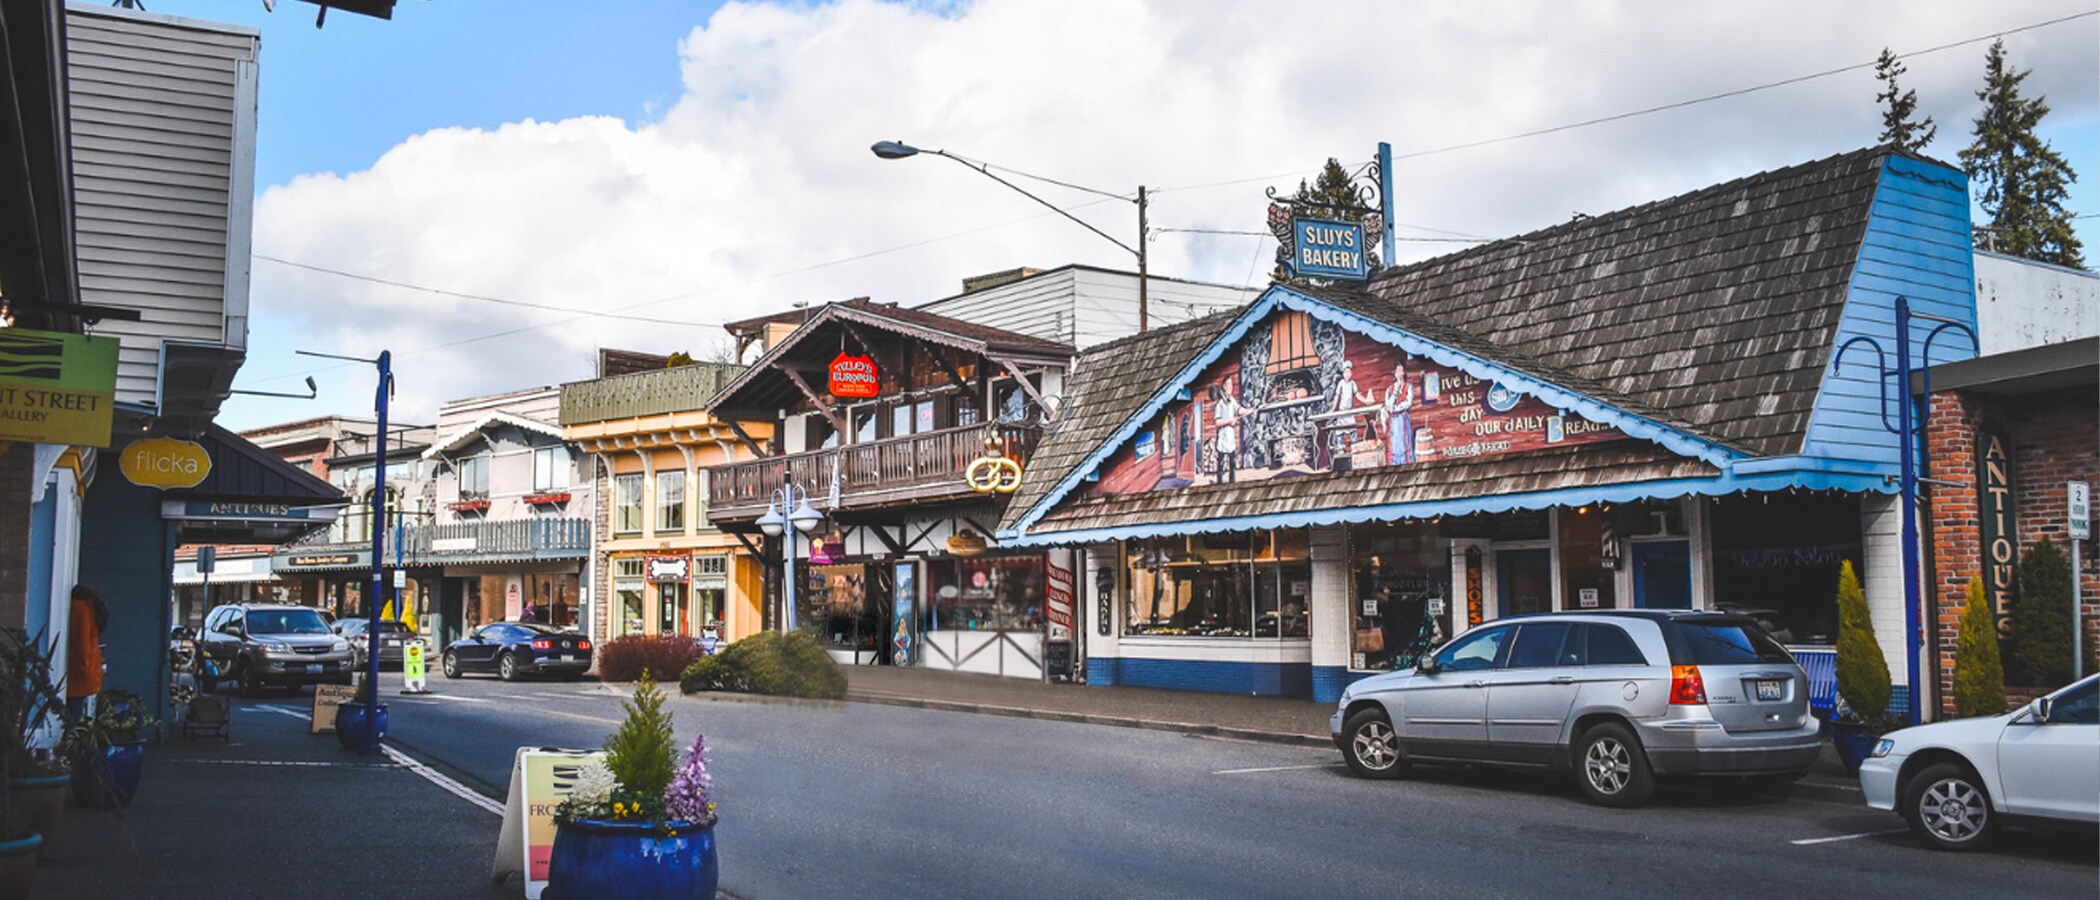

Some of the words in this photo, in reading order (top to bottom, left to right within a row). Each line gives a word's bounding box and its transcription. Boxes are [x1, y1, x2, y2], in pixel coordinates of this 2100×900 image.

[1305, 225, 1358, 248] SLUYS'
[1302, 247, 1360, 270] BAKERY
[24, 389, 101, 412] STREET
[1475, 421, 1501, 436] OUR
[136, 450, 199, 474] flicka
[2076, 490, 2081, 501] 2
[210, 502, 289, 516] ANTIQUES
[1985, 435, 2015, 640] ANTIQUES
[1468, 567, 1482, 624] SHOES
